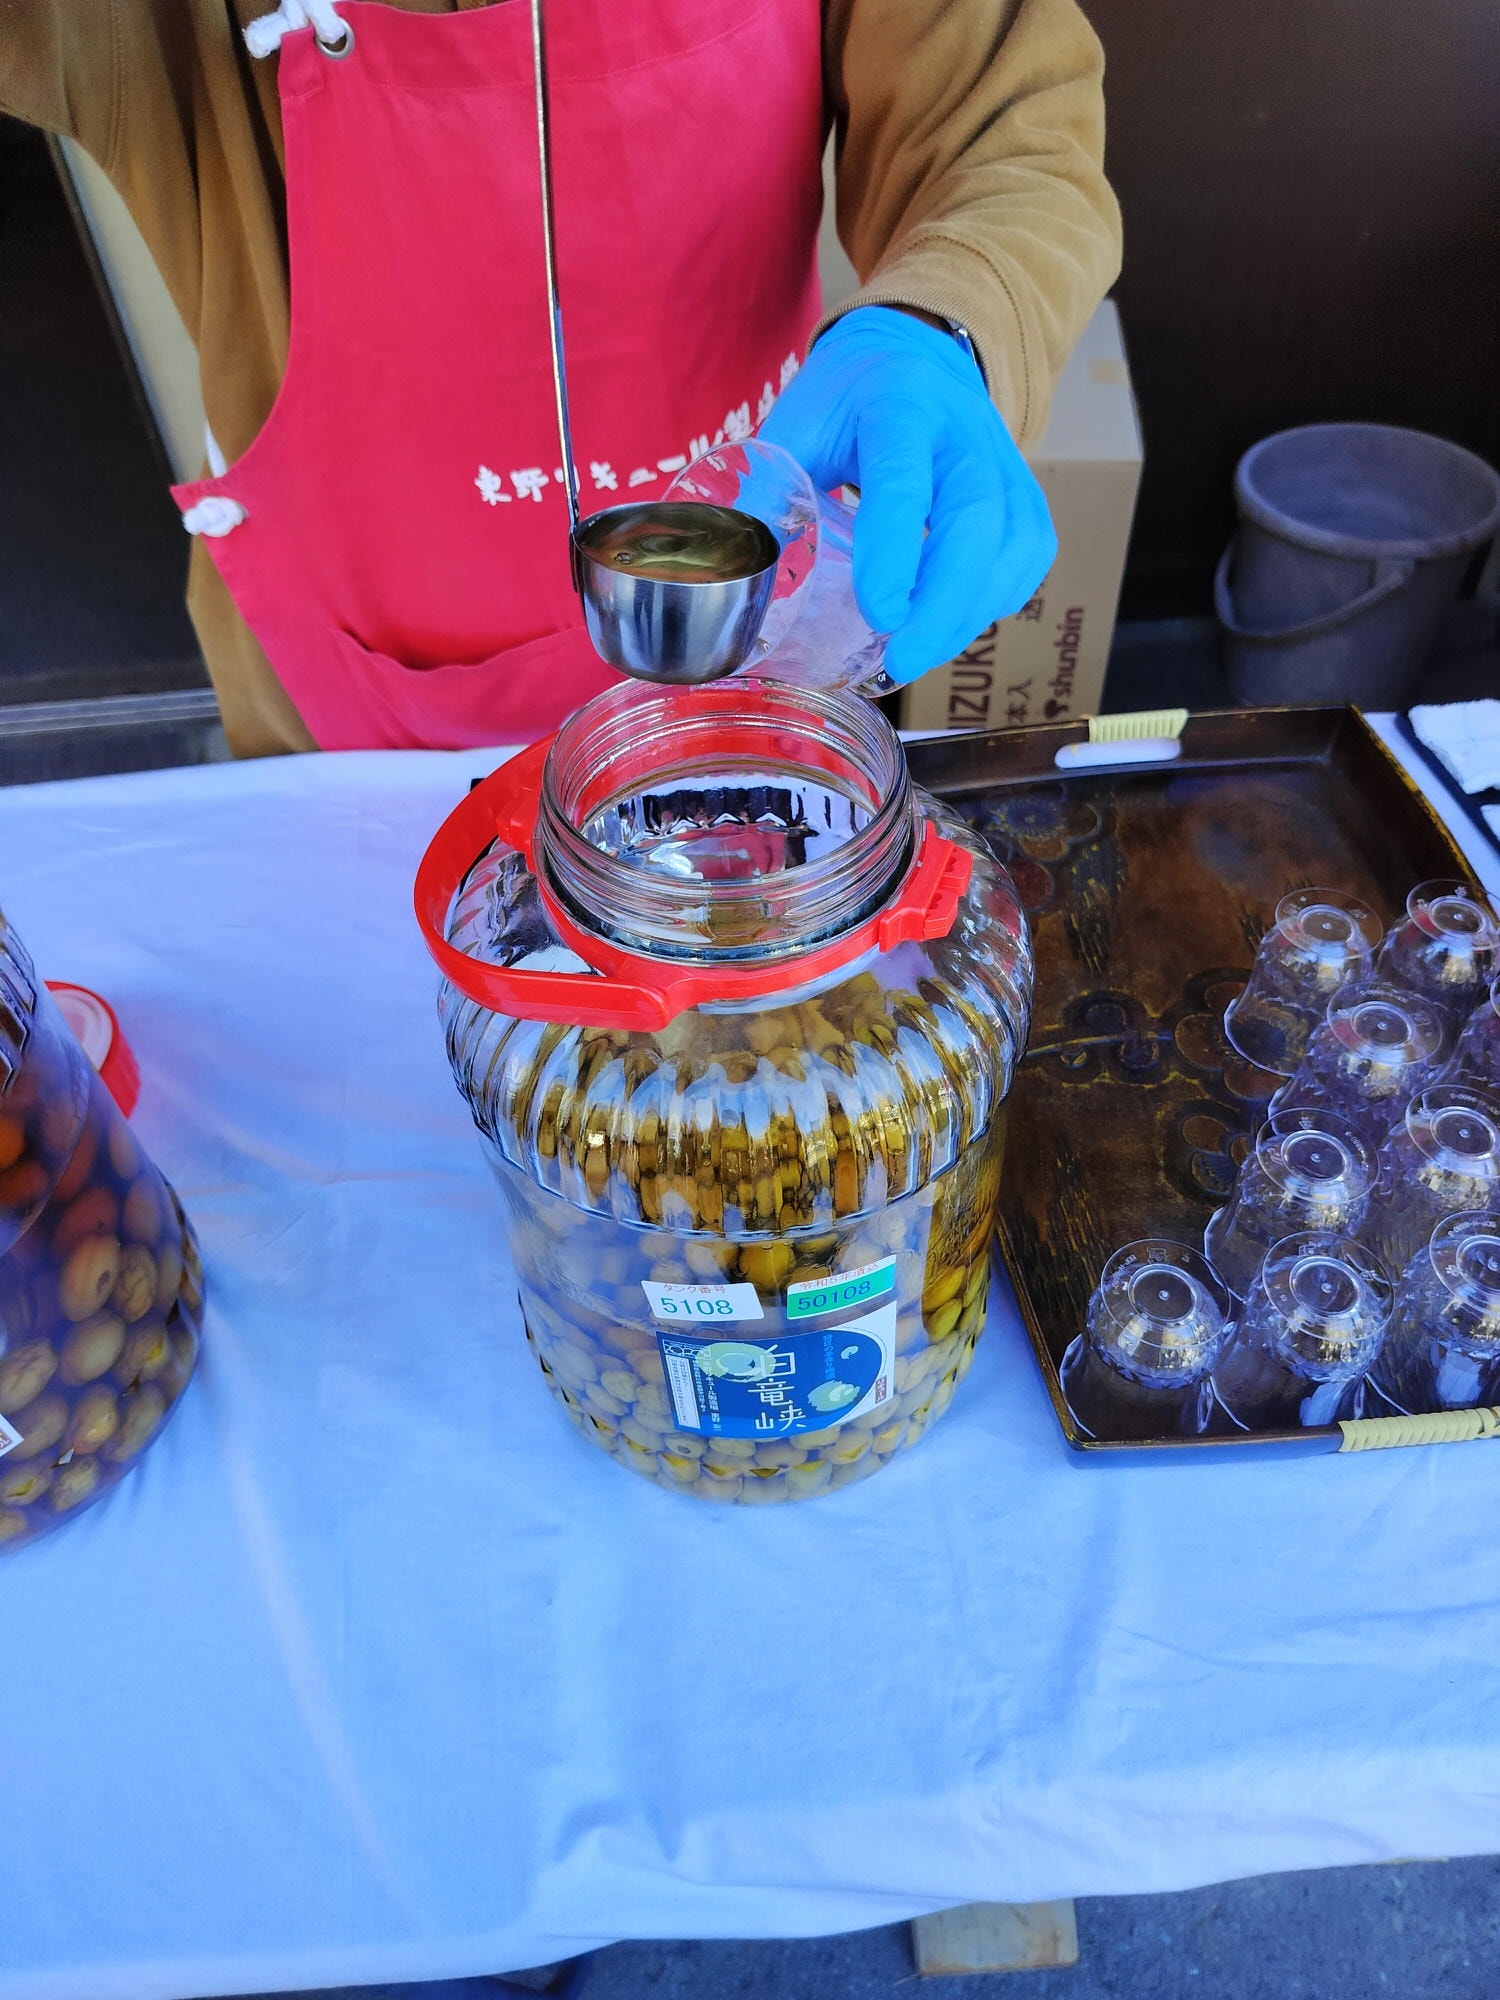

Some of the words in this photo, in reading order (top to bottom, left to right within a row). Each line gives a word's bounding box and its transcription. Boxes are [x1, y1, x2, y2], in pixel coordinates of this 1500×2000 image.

[947, 622, 998, 728] IZUK
[1048, 605, 1085, 697] shunbin
[660, 1297, 734, 1315] 5108
[663, 1283, 727, 1294] タンク番号
[797, 1280, 872, 1311] 50108
[747, 1344, 807, 1432] 白竜峡
